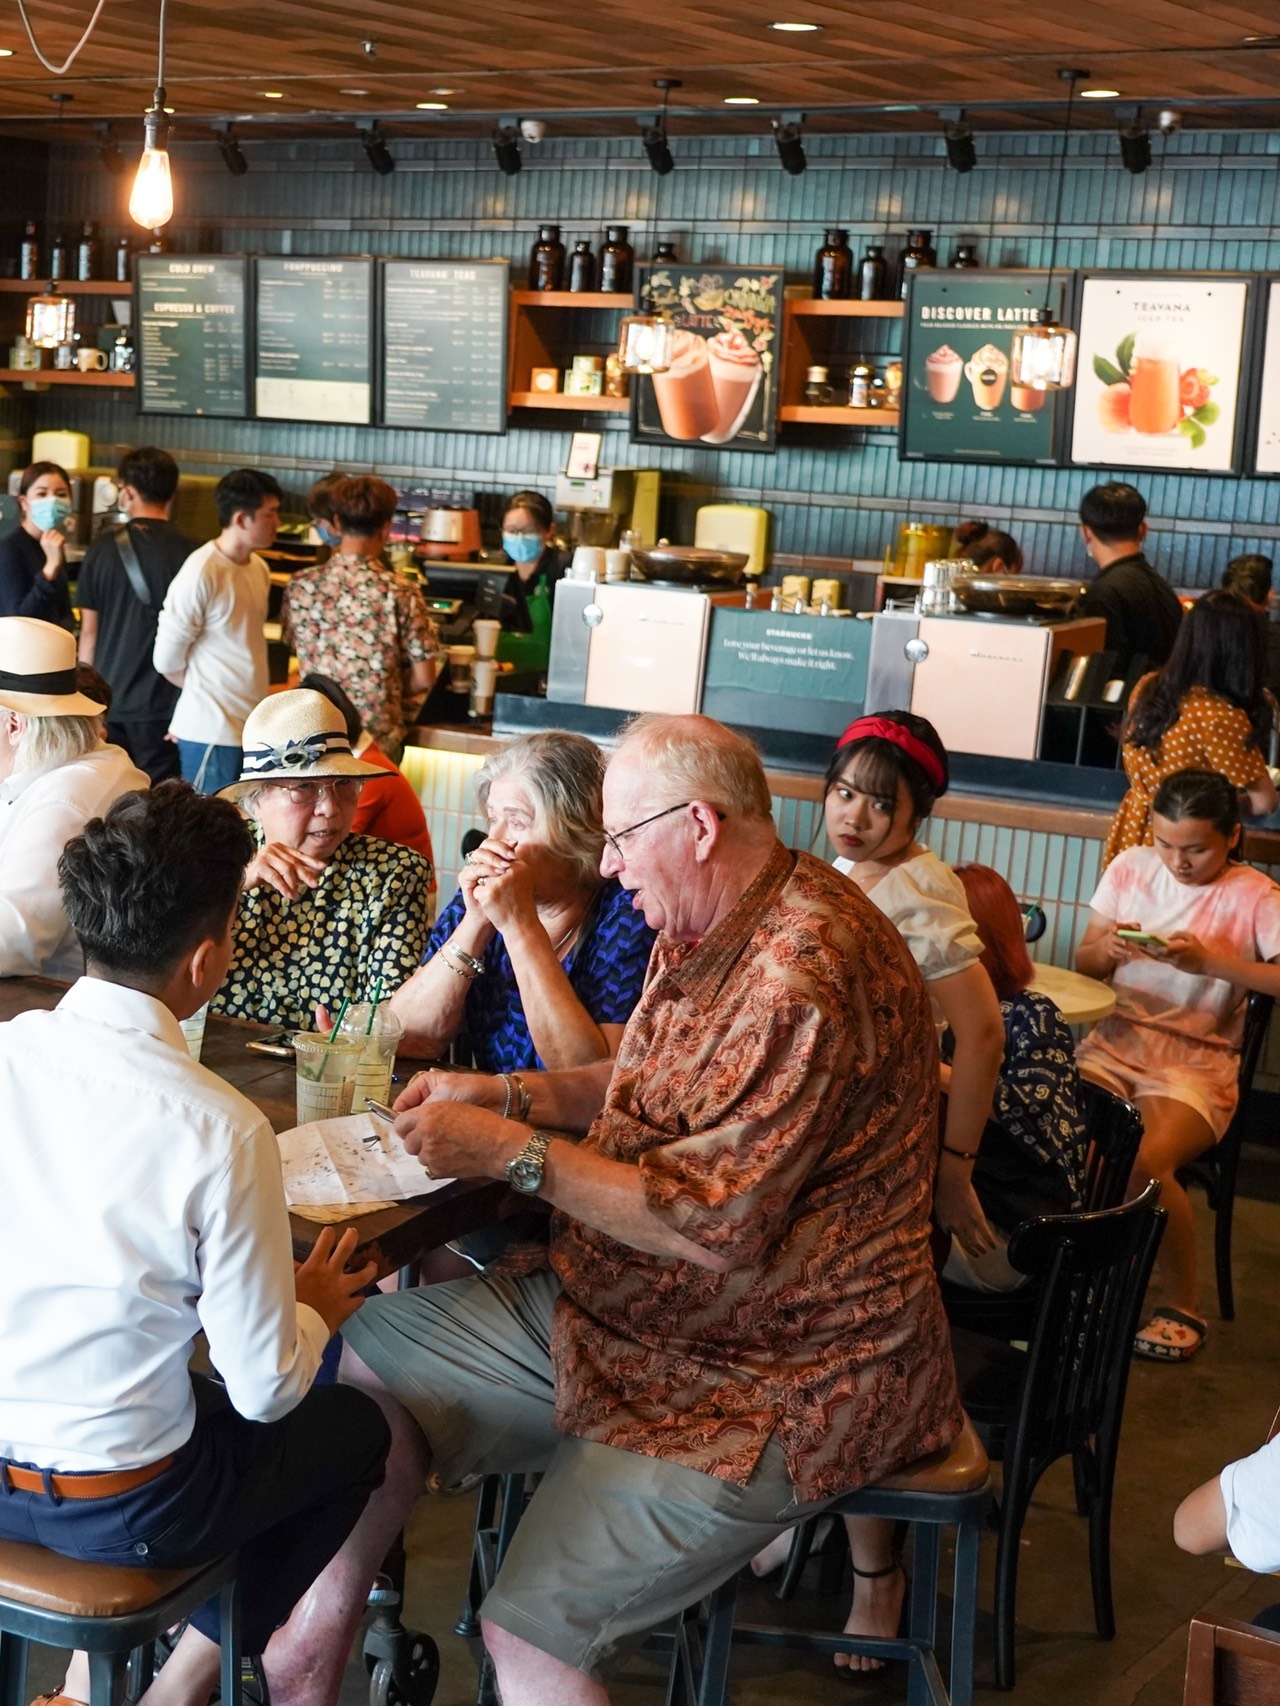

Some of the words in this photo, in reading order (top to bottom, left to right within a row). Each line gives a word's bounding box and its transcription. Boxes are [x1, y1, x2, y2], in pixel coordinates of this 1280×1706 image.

[153, 302, 195, 313] ESPRESSO
[204, 304, 235, 314] COFFEE
[1132, 301, 1191, 312] TEAVANA
[921, 306, 992, 321] DISCOVER
[997, 307, 1040, 322] LATTE
[766, 629, 813, 640] STARBUCKS
[723, 638, 740, 649] Love
[740, 642, 761, 652] your
[761, 642, 797, 655] beverage
[807, 646, 818, 656] let
[829, 649, 854, 660] know.
[758, 652, 784, 665] always
[784, 656, 807, 667] make
